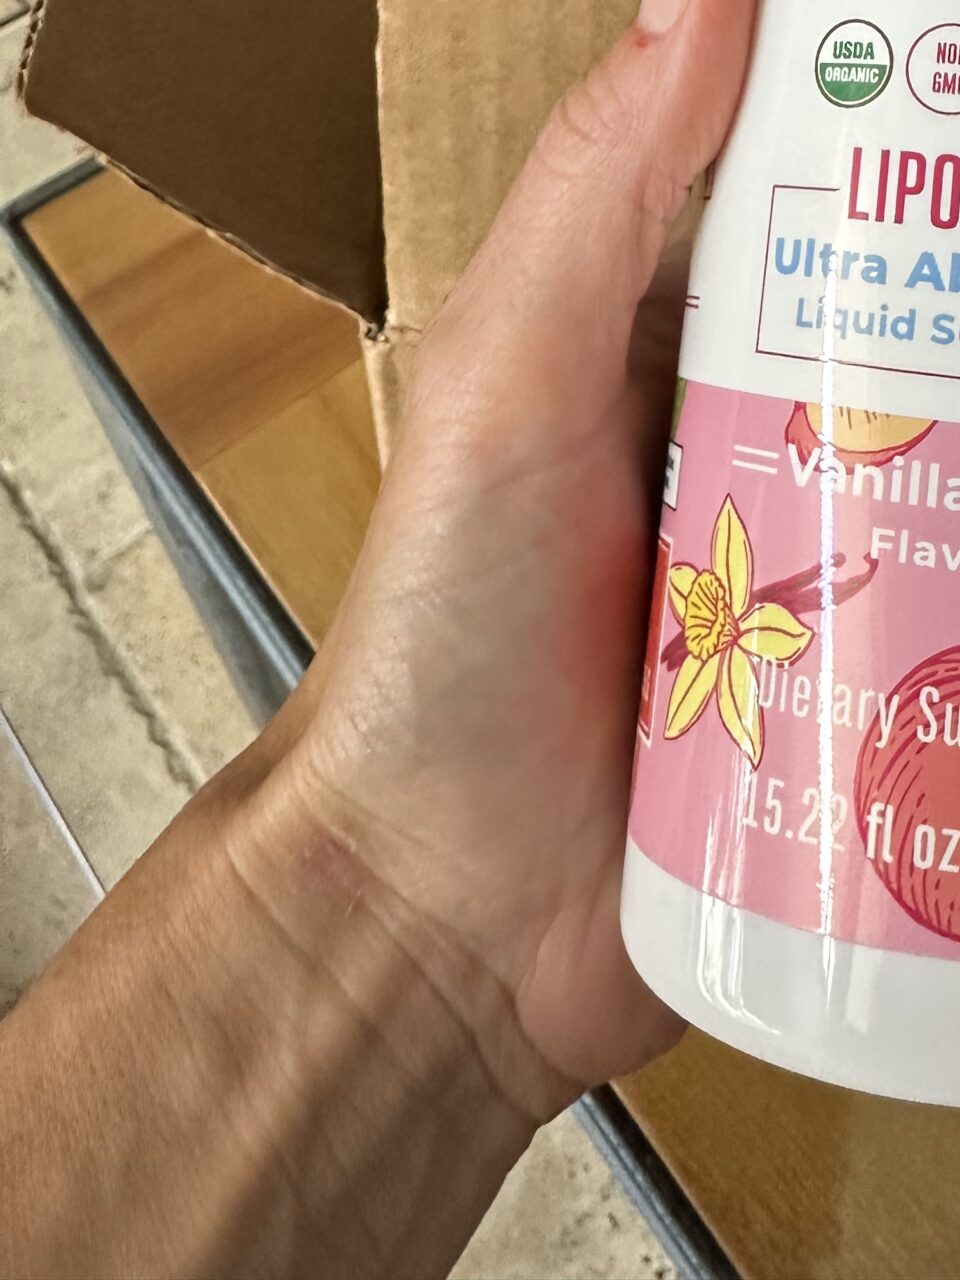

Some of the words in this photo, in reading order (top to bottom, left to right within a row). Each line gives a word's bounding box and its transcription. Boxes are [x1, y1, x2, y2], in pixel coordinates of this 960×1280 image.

[833, 40, 875, 60] USDA
[824, 66, 879, 84] ORGANIC
[774, 237, 888, 285] Ultra
[795, 297, 916, 341] Liquid
[758, 658, 901, 749] Dieary
[742, 770, 849, 852] 15.22
[866, 801, 893, 863] fl
[913, 823, 960, 874] oz
